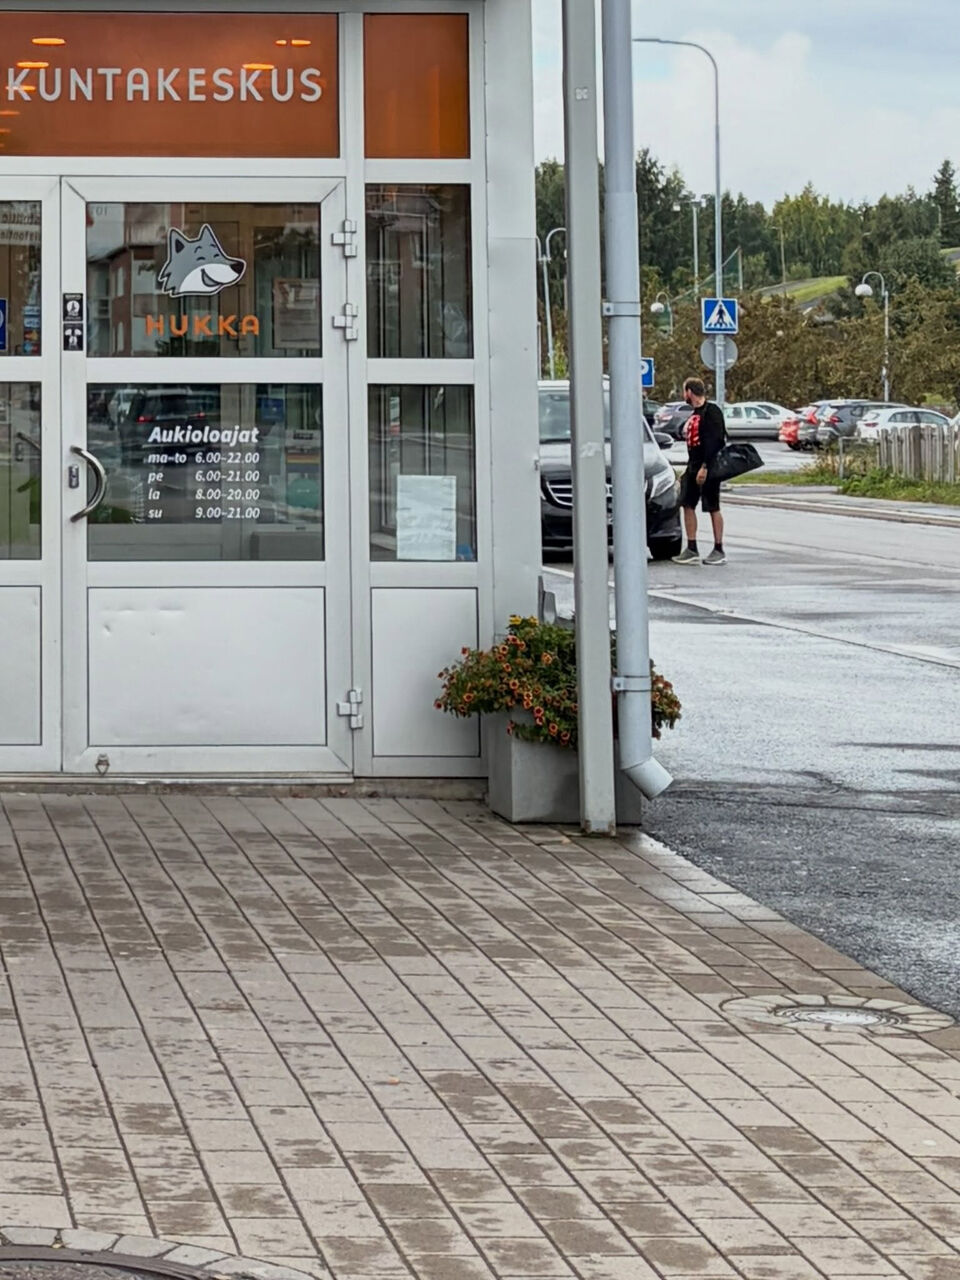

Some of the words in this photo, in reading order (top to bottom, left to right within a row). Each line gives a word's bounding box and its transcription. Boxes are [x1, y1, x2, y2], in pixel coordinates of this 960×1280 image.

[145, 314, 260, 337] HUKKA
[147, 425, 260, 447] Aukioloajat
[147, 472, 164, 484] pe
[148, 489, 161, 500] la
[147, 509, 163, 519] su
